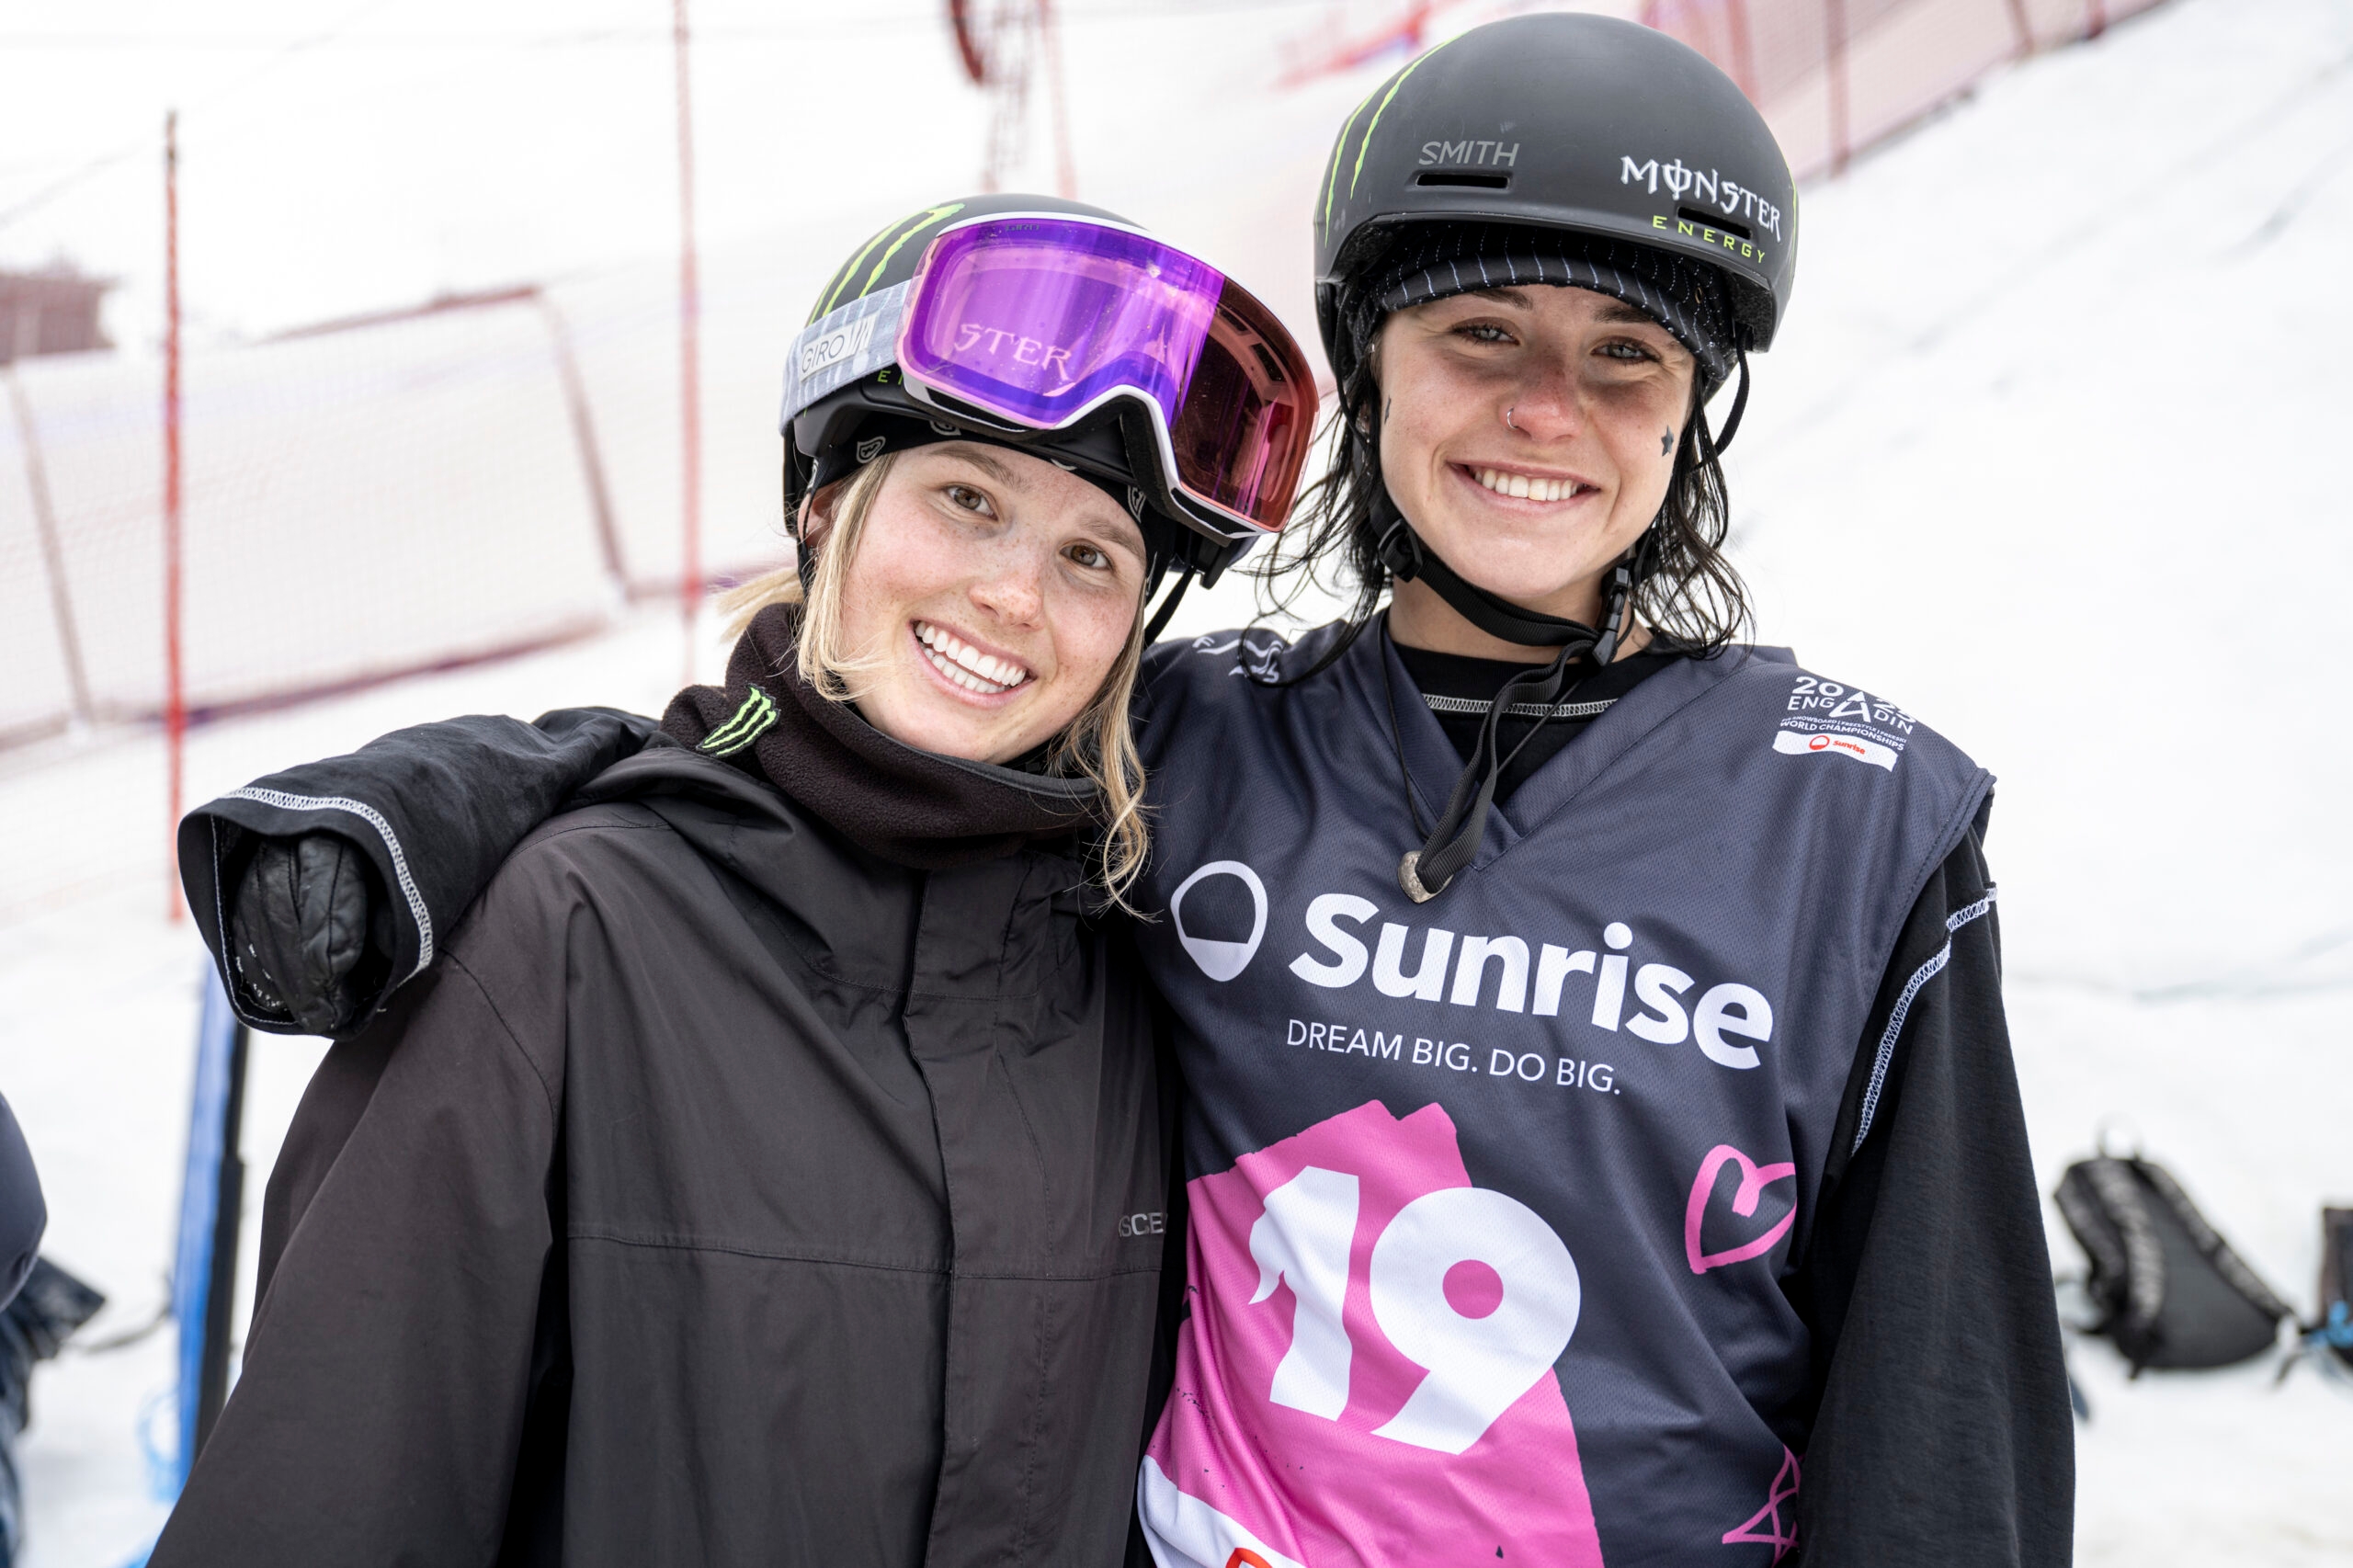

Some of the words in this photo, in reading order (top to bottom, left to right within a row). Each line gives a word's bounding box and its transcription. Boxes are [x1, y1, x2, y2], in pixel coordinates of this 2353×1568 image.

[1418, 141, 1519, 166] SMITH
[1620, 155, 1781, 243] MONSTER
[1653, 215, 1766, 264] ENERGY
[801, 335, 845, 373] GIRO
[1779, 720, 1818, 731] WORLD
[1819, 724, 1905, 751] CHAMPIONSHIPS
[1792, 715, 1836, 724] SNOWBOARD
[1840, 721, 1877, 733] FREESTYLE
[1833, 740, 1866, 755] sunrise
[1288, 892, 1774, 1070] Sunrise
[1287, 1019, 1403, 1062] DREAM
[1412, 1038, 1478, 1073] BIG.
[1489, 1050, 1546, 1082] DO
[1556, 1059, 1621, 1095] BIG.
[1119, 1211, 1168, 1237] SCE
[1248, 1165, 1581, 1455] 19
